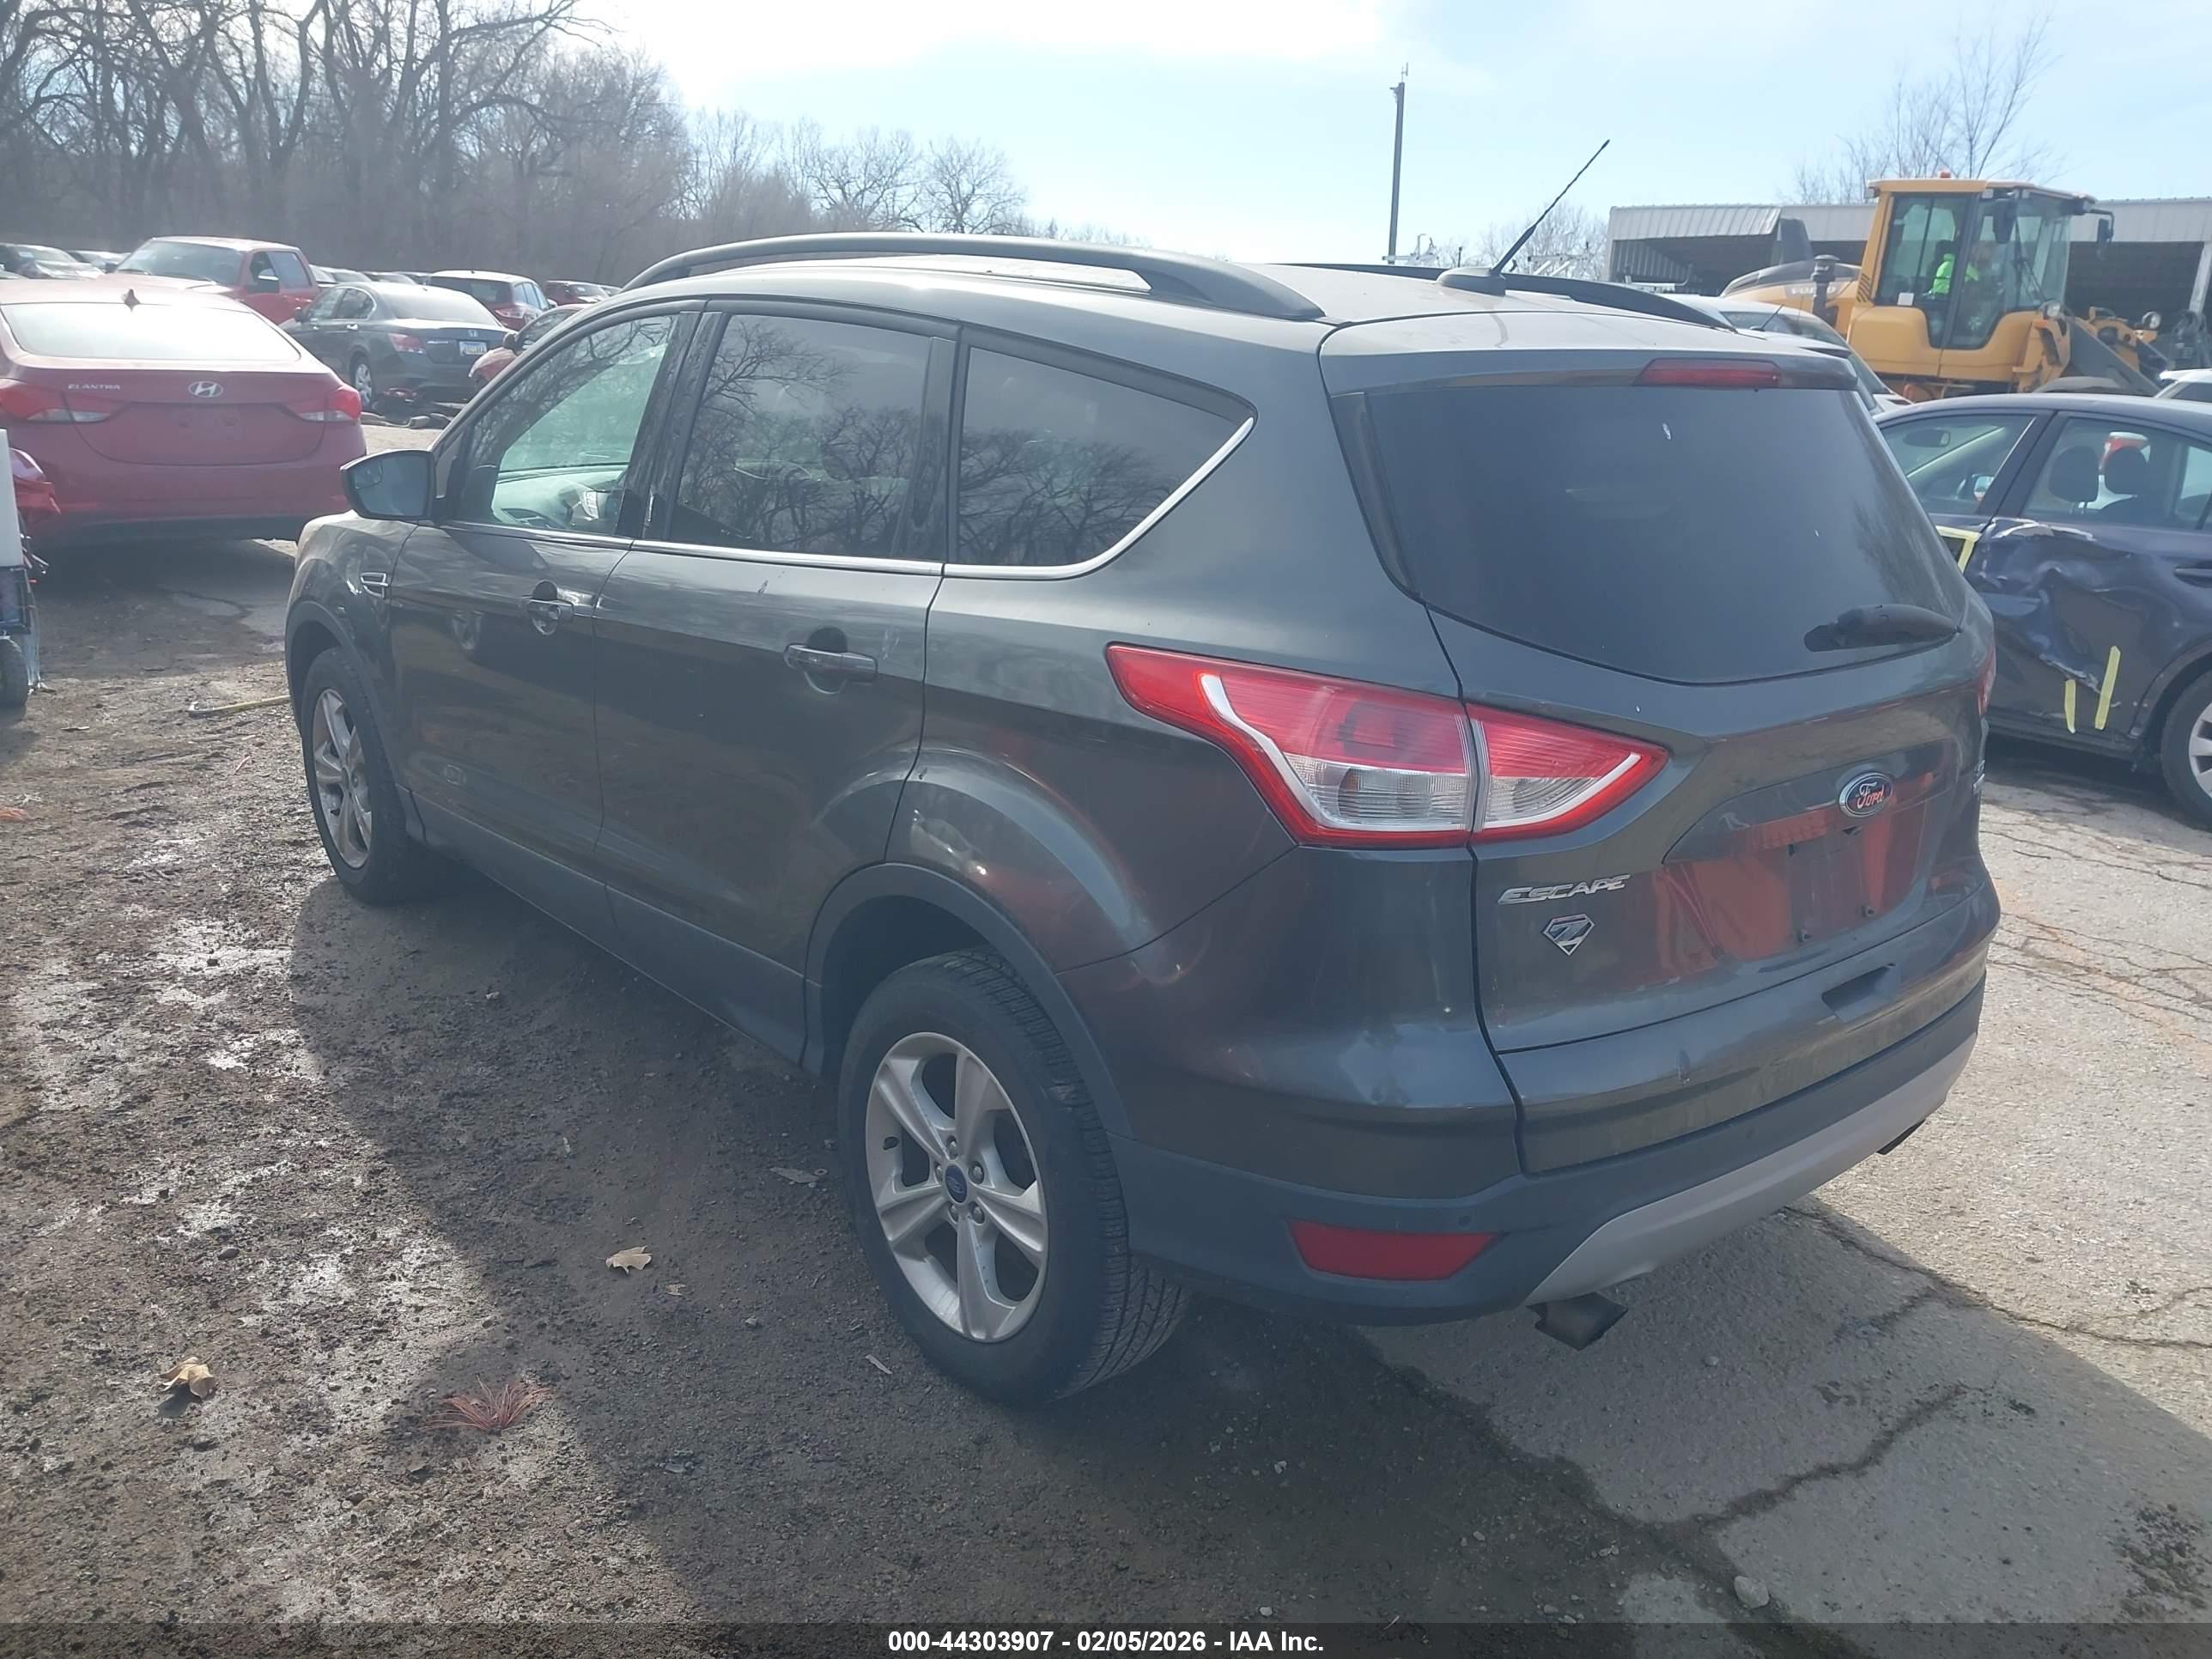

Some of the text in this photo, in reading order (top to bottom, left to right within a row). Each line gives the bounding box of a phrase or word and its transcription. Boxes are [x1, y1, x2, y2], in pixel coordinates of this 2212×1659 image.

[1790, 286, 1836, 295] VOLO
[1856, 781, 1885, 809] Ford
[1498, 874, 1631, 904] ESCAPE
